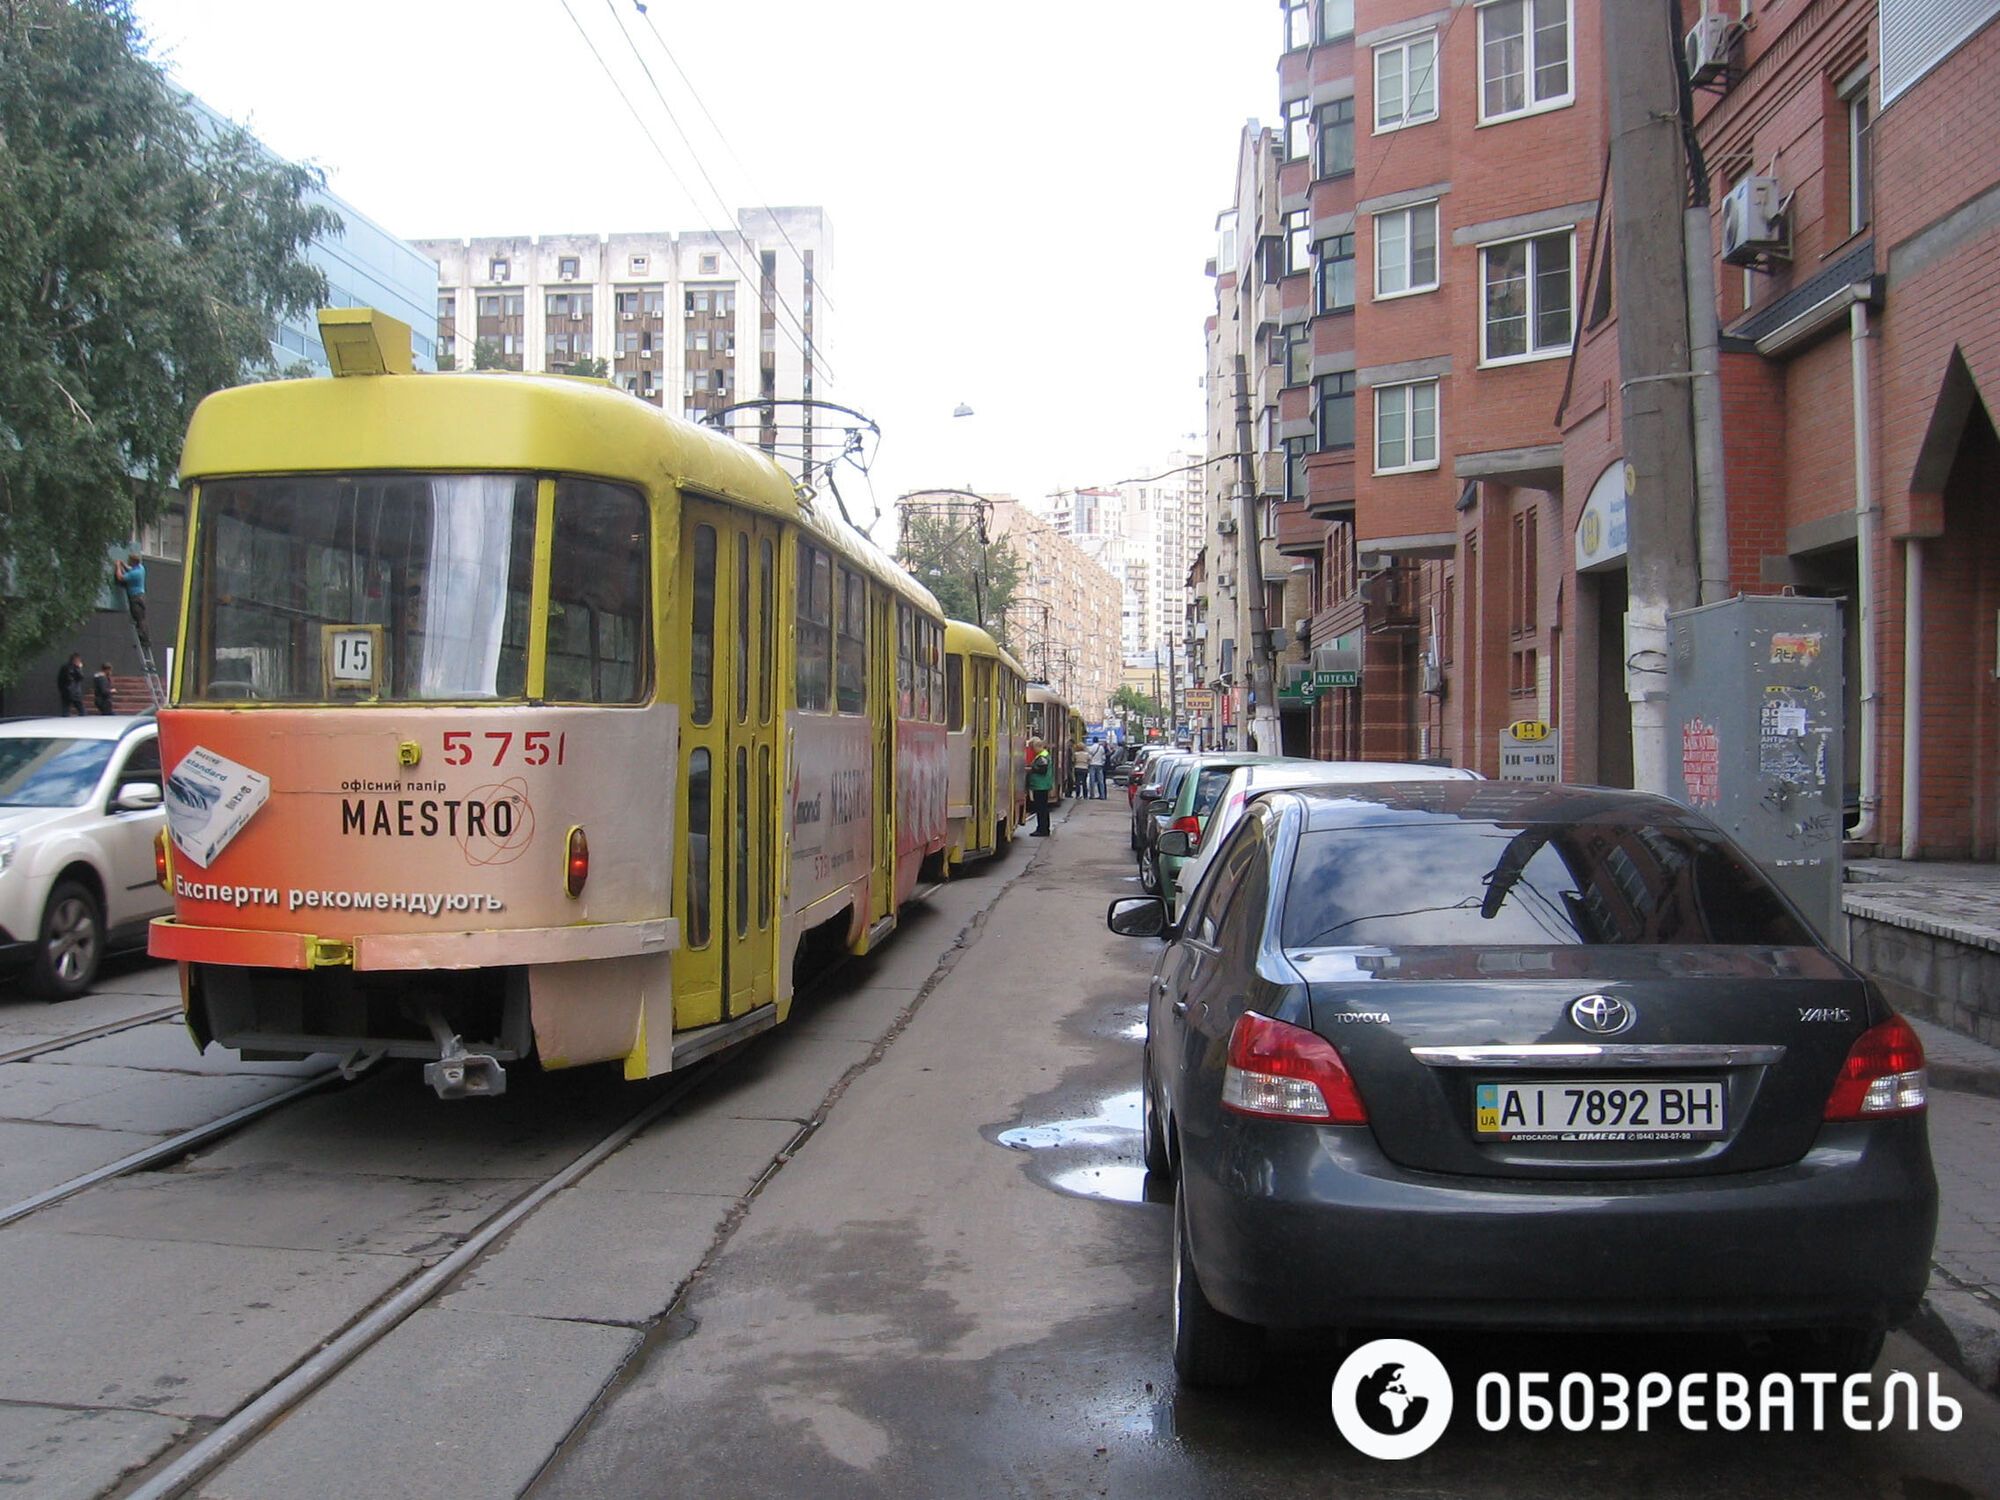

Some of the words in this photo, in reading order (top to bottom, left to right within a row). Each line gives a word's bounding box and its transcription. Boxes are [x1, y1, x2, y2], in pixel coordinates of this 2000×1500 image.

[341, 639, 369, 671] 15
[1301, 681, 1314, 695] 24
[1317, 674, 1354, 684] АПТЕКА
[443, 731, 566, 767] 5751
[186, 758, 228, 781] standard
[341, 779, 401, 793] офісний
[407, 779, 447, 793] папір
[341, 799, 513, 837] MAESTRO
[175, 874, 279, 908] Експерти
[288, 888, 503, 915] рекомендують
[1334, 1012, 1391, 1024] TOYOTA
[1501, 1090, 1544, 1126] AI
[1564, 1089, 1649, 1126] 7892
[1660, 1088, 1712, 1125] BH
[1480, 1115, 1497, 1126] UA
